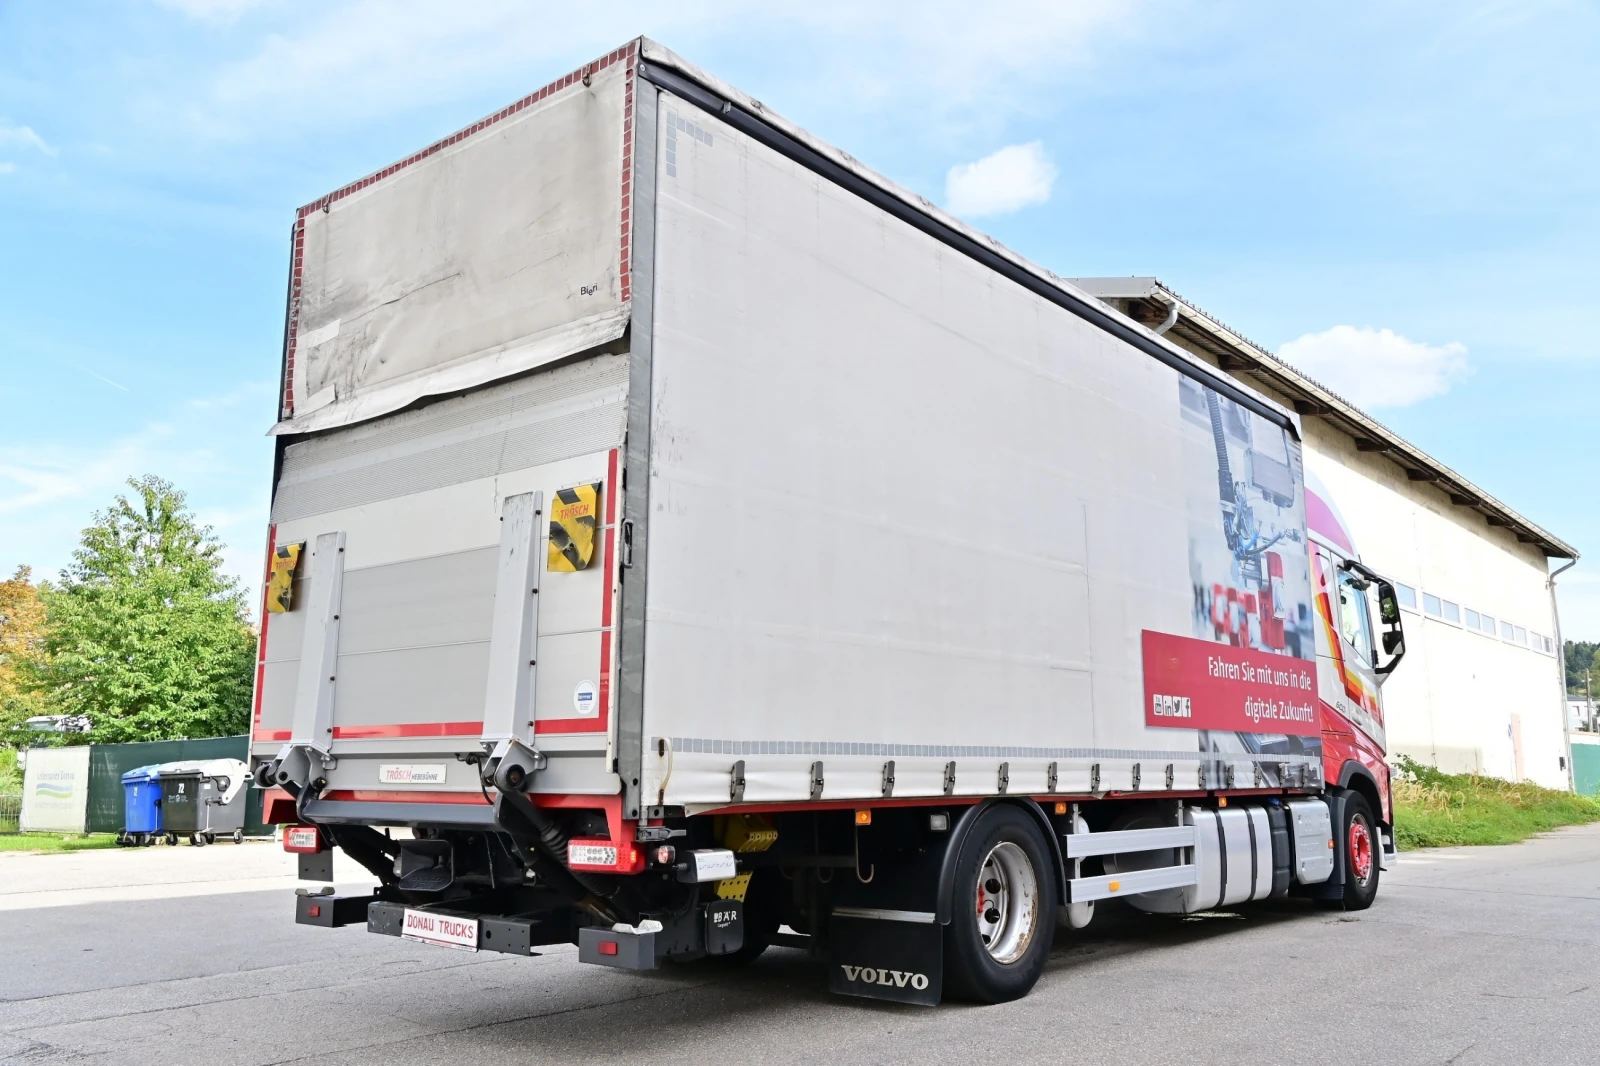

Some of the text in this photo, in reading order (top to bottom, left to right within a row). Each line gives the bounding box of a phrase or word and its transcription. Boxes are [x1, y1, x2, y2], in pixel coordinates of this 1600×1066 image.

[580, 282, 598, 296] Bieri
[560, 504, 589, 519] TRÖSCH
[1208, 656, 1312, 691] Fahren Sie mit uns in die
[1244, 695, 1314, 723] digitale Zukunft!
[386, 767, 438, 781] TRÖSCH HEBEBÜHNE
[718, 910, 737, 922] BÄR
[407, 914, 474, 939] DONAU TRUCKS
[841, 965, 929, 990] VOLVO
